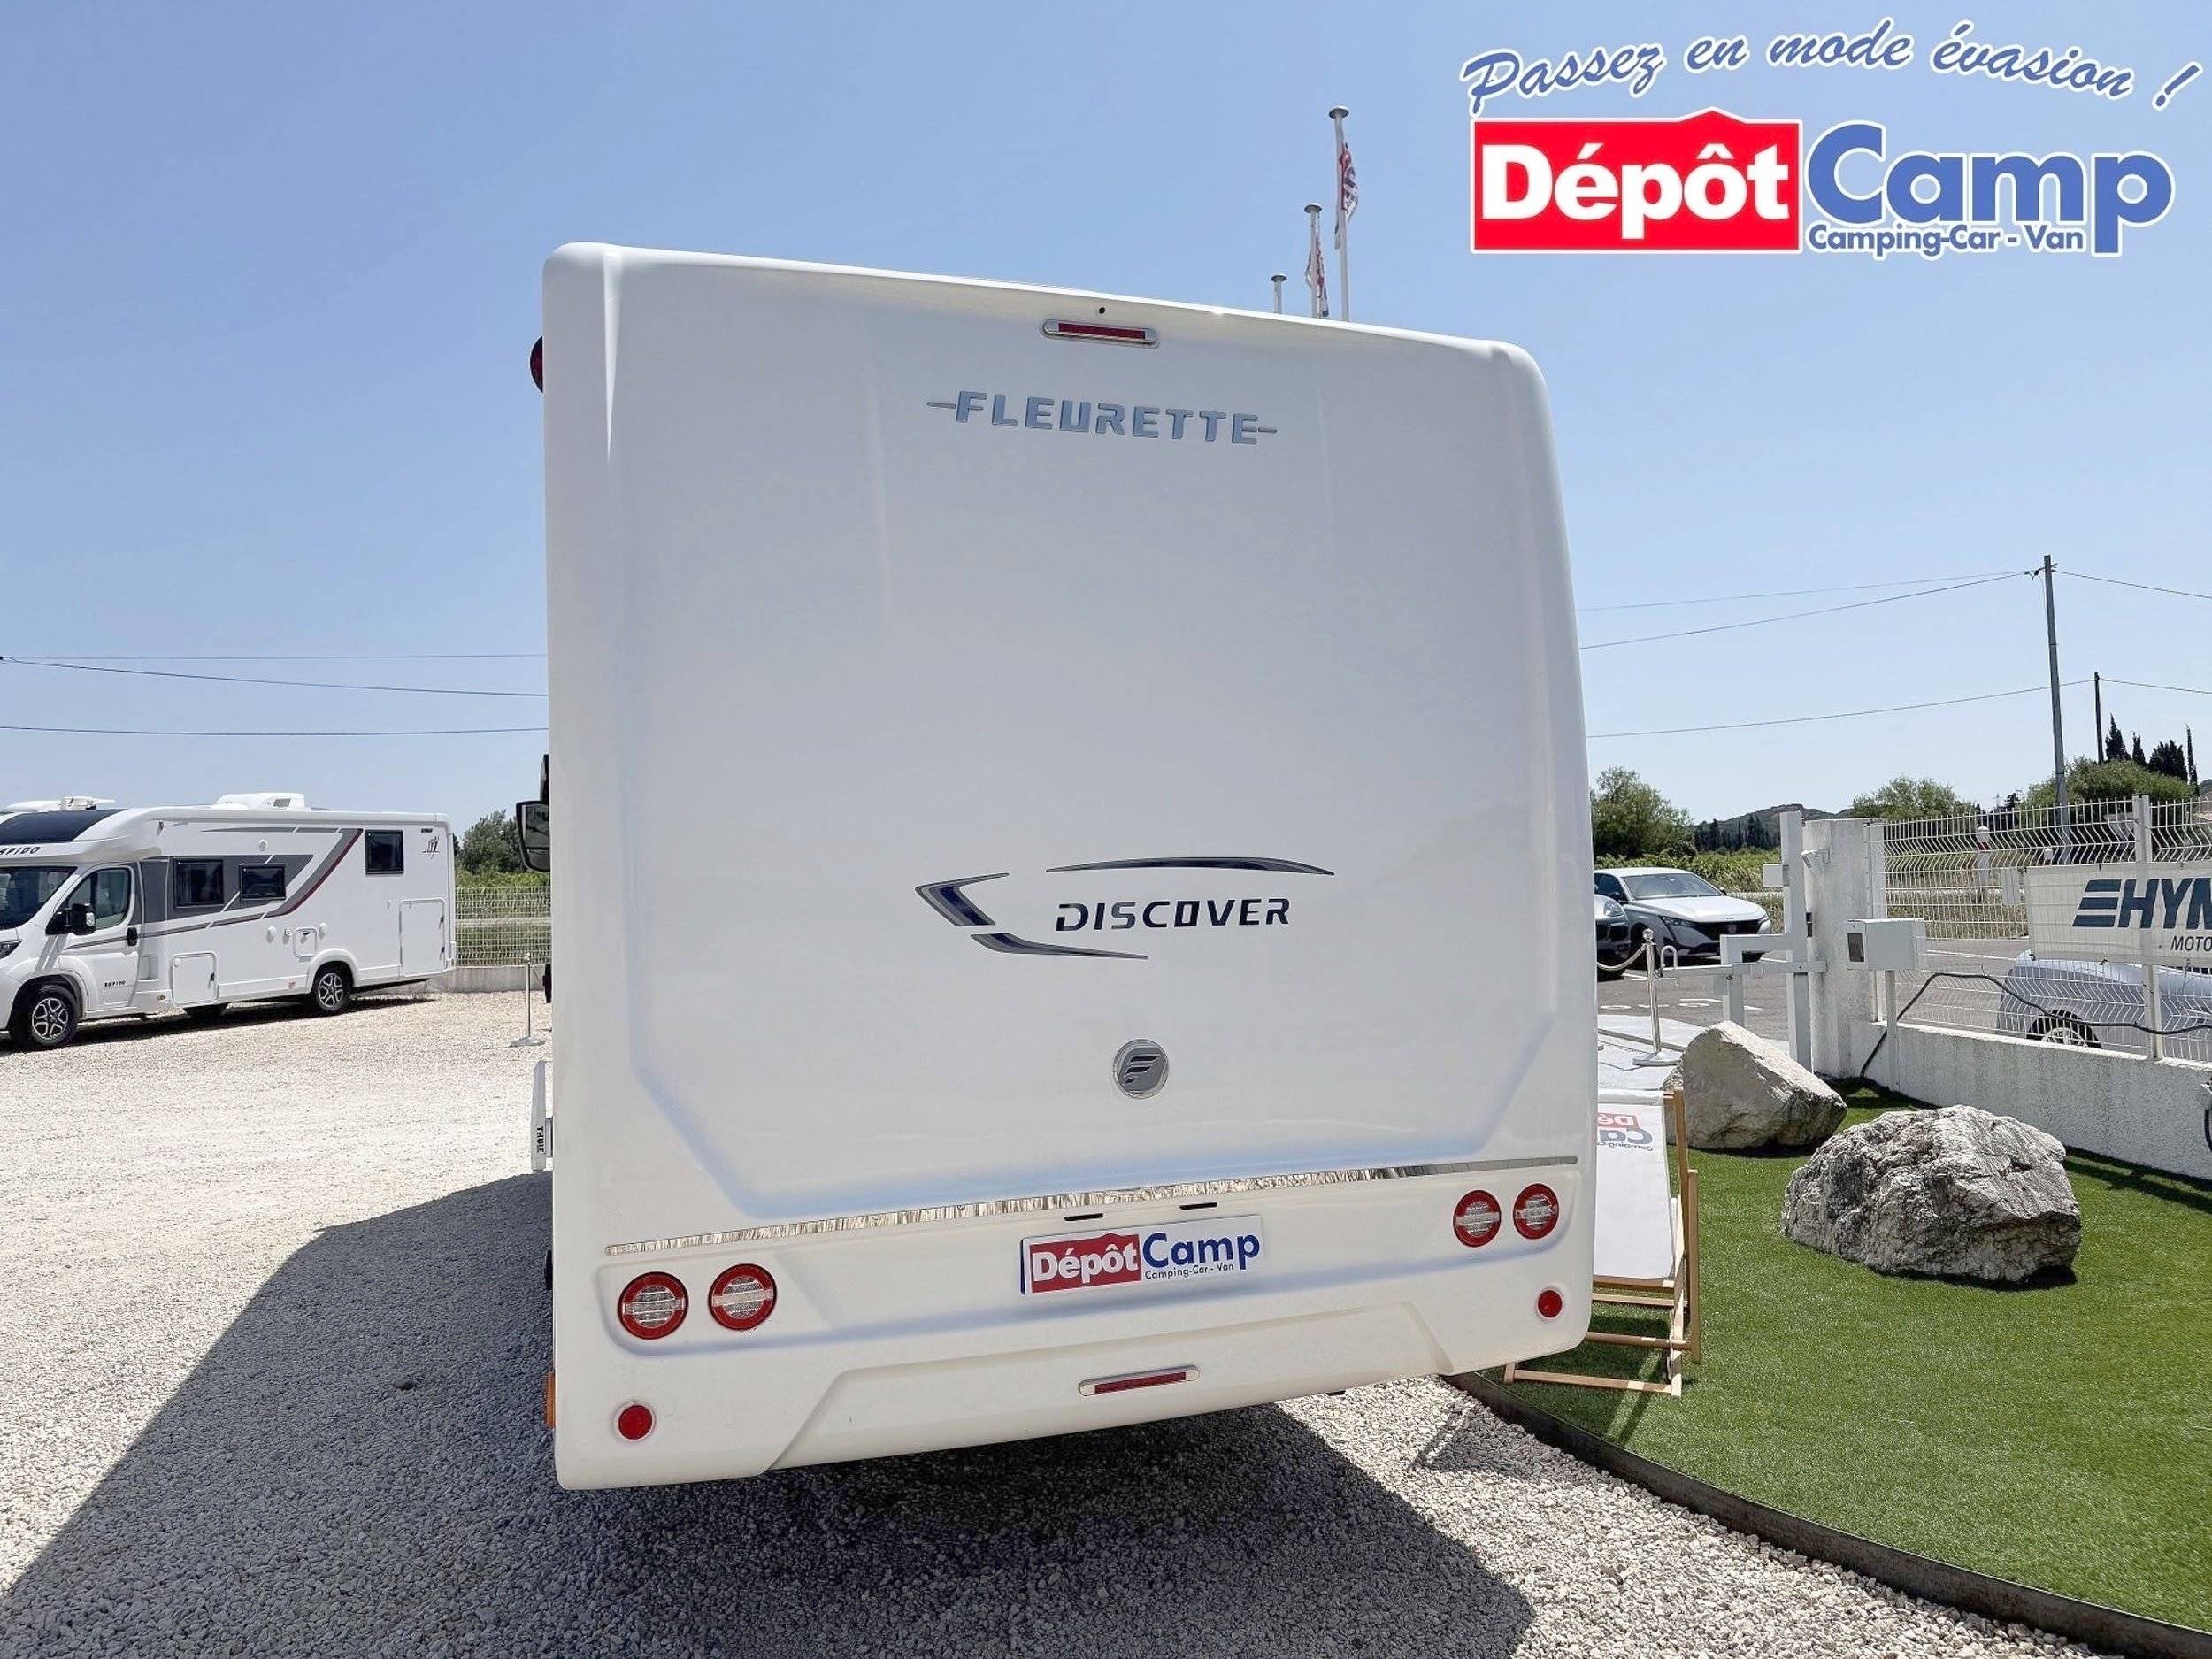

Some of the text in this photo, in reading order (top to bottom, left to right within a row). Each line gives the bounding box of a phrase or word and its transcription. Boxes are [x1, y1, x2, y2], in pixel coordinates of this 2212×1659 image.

[956, 390, 1259, 445] FLEURETTE
[1055, 898, 1290, 932] DISCOVER
[536, 1125, 545, 1154] THULE
[1032, 1232, 1260, 1283] Dépôt Camp
[1216, 1263, 1234, 1271] Van
